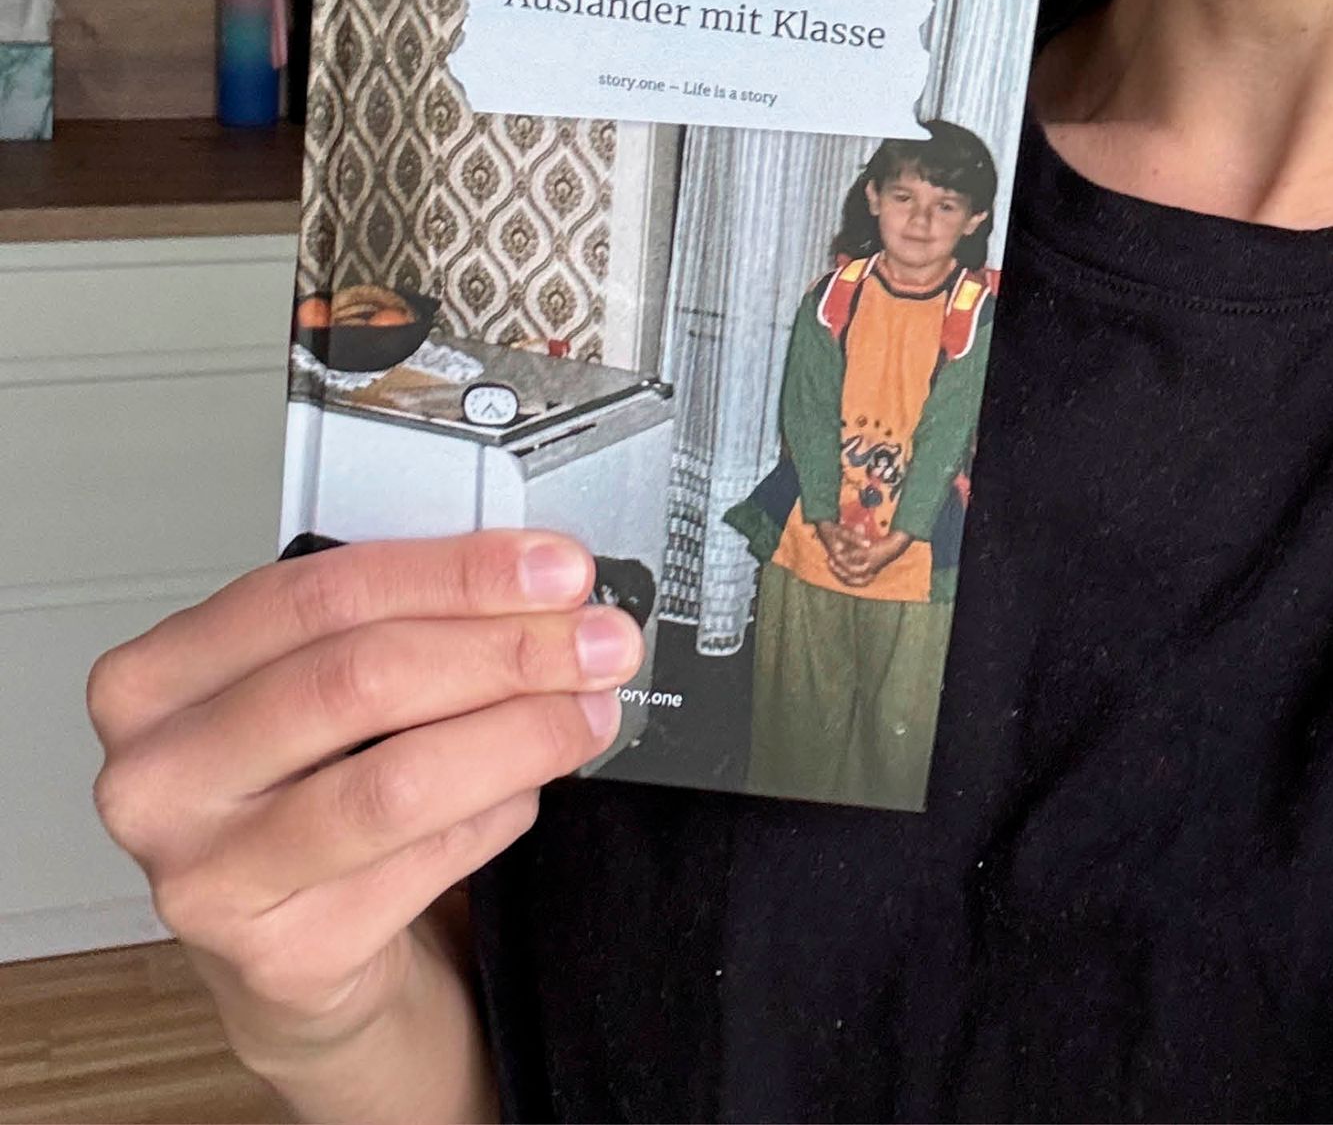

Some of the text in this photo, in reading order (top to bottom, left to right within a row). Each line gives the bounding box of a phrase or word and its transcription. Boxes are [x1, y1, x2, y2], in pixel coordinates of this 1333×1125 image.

[699, 4, 762, 36] mit
[771, 9, 886, 50] Klasse
[598, 74, 666, 92] story.one
[682, 81, 711, 97] Life
[713, 85, 726, 99] is
[728, 88, 738, 101] a
[740, 89, 778, 108] story
[615, 686, 683, 708] tory.one
